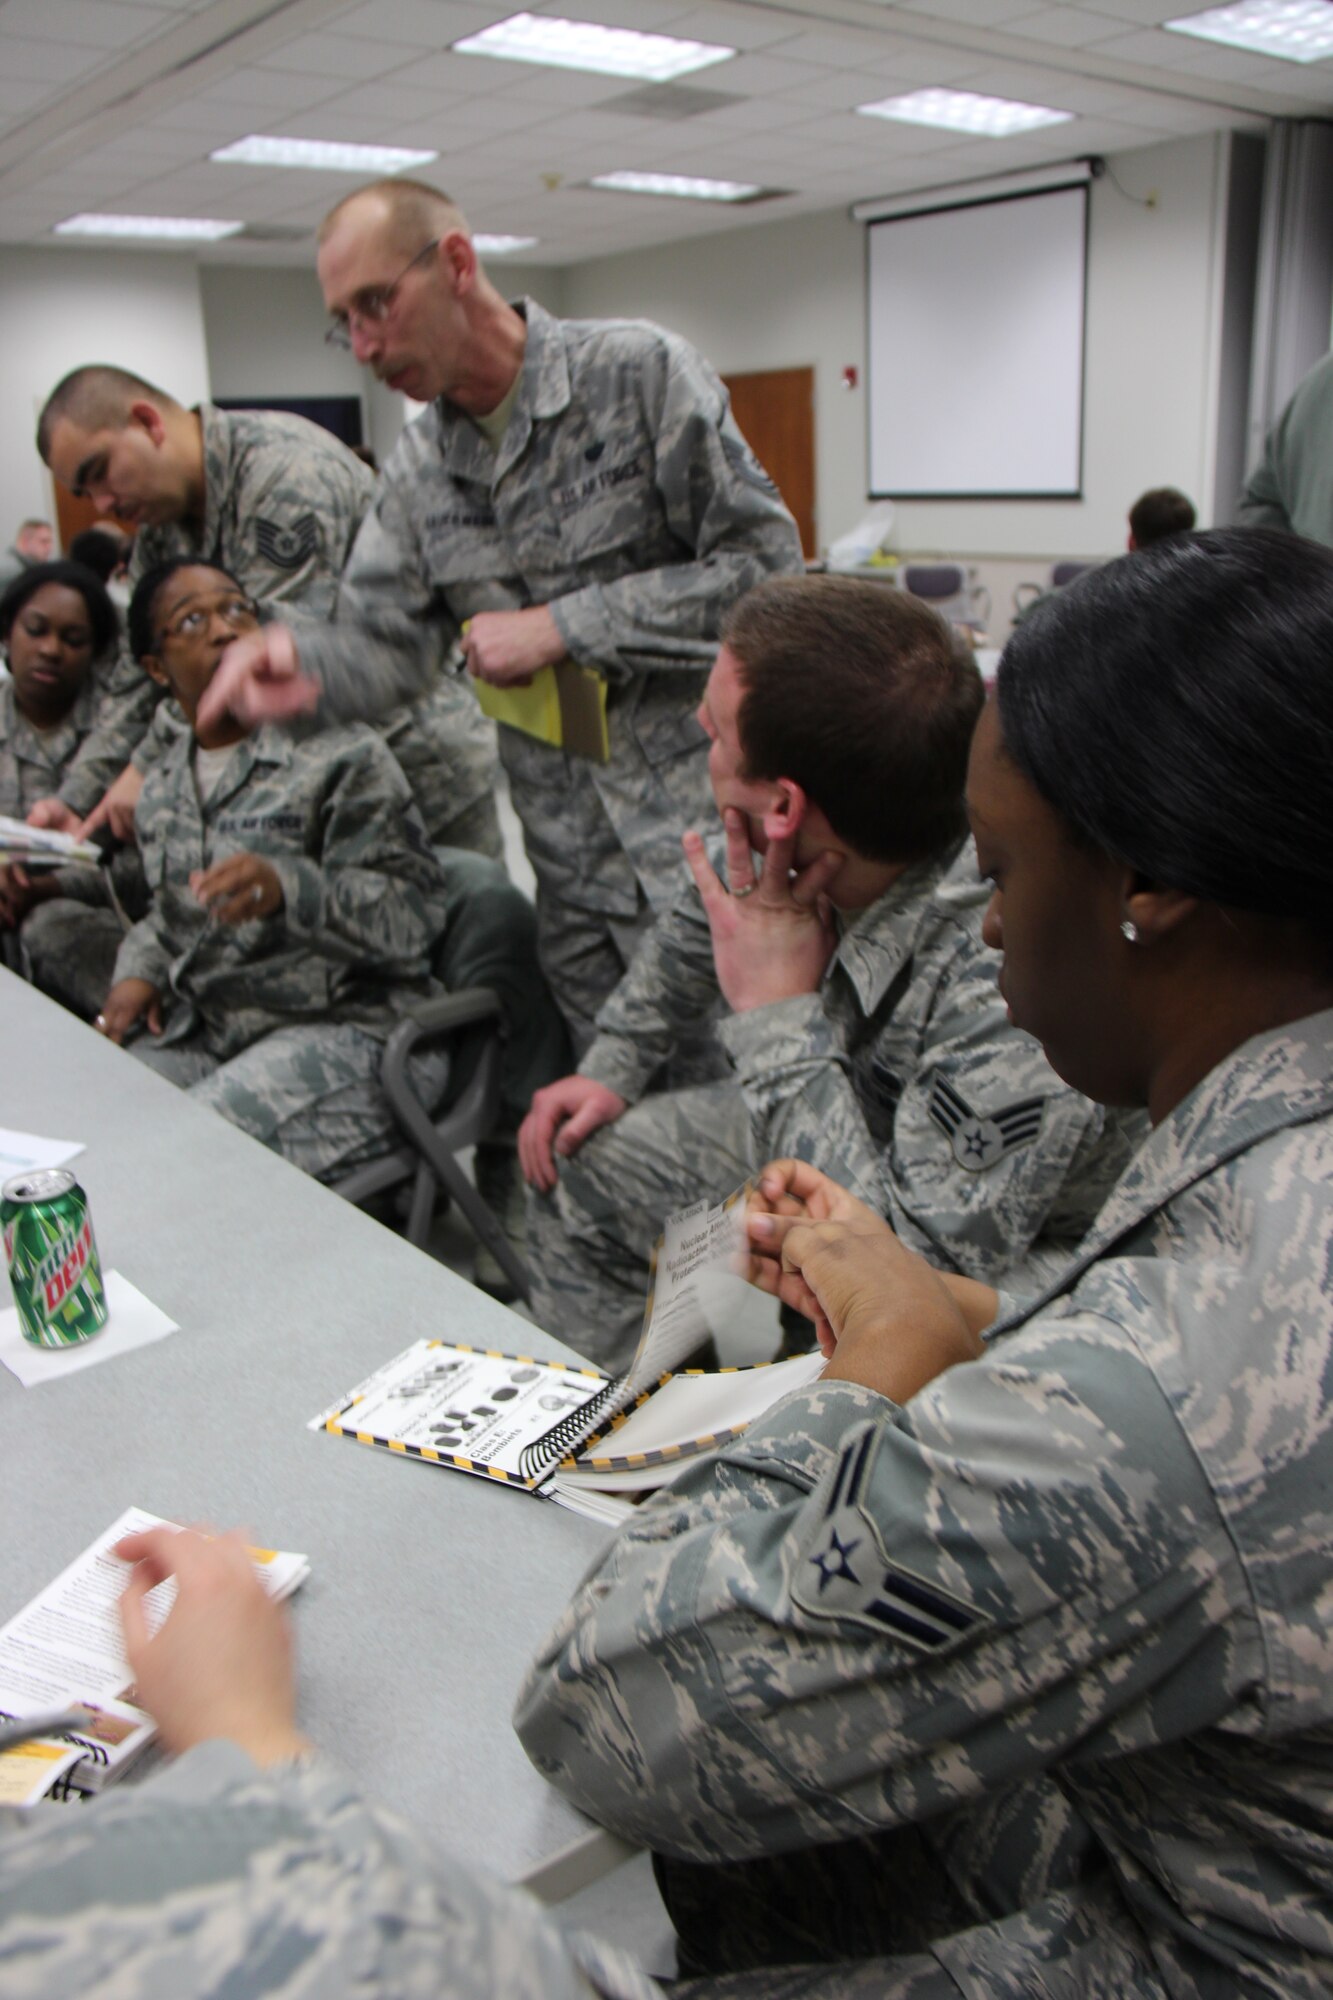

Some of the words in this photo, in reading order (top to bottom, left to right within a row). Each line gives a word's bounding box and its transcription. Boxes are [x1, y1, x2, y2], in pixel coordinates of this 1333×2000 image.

[680, 1229, 709, 1252] Nuclear
[470, 1437, 499, 1459] Class
[495, 1428, 507, 1440] E:
[481, 1428, 523, 1463] Bomblets
